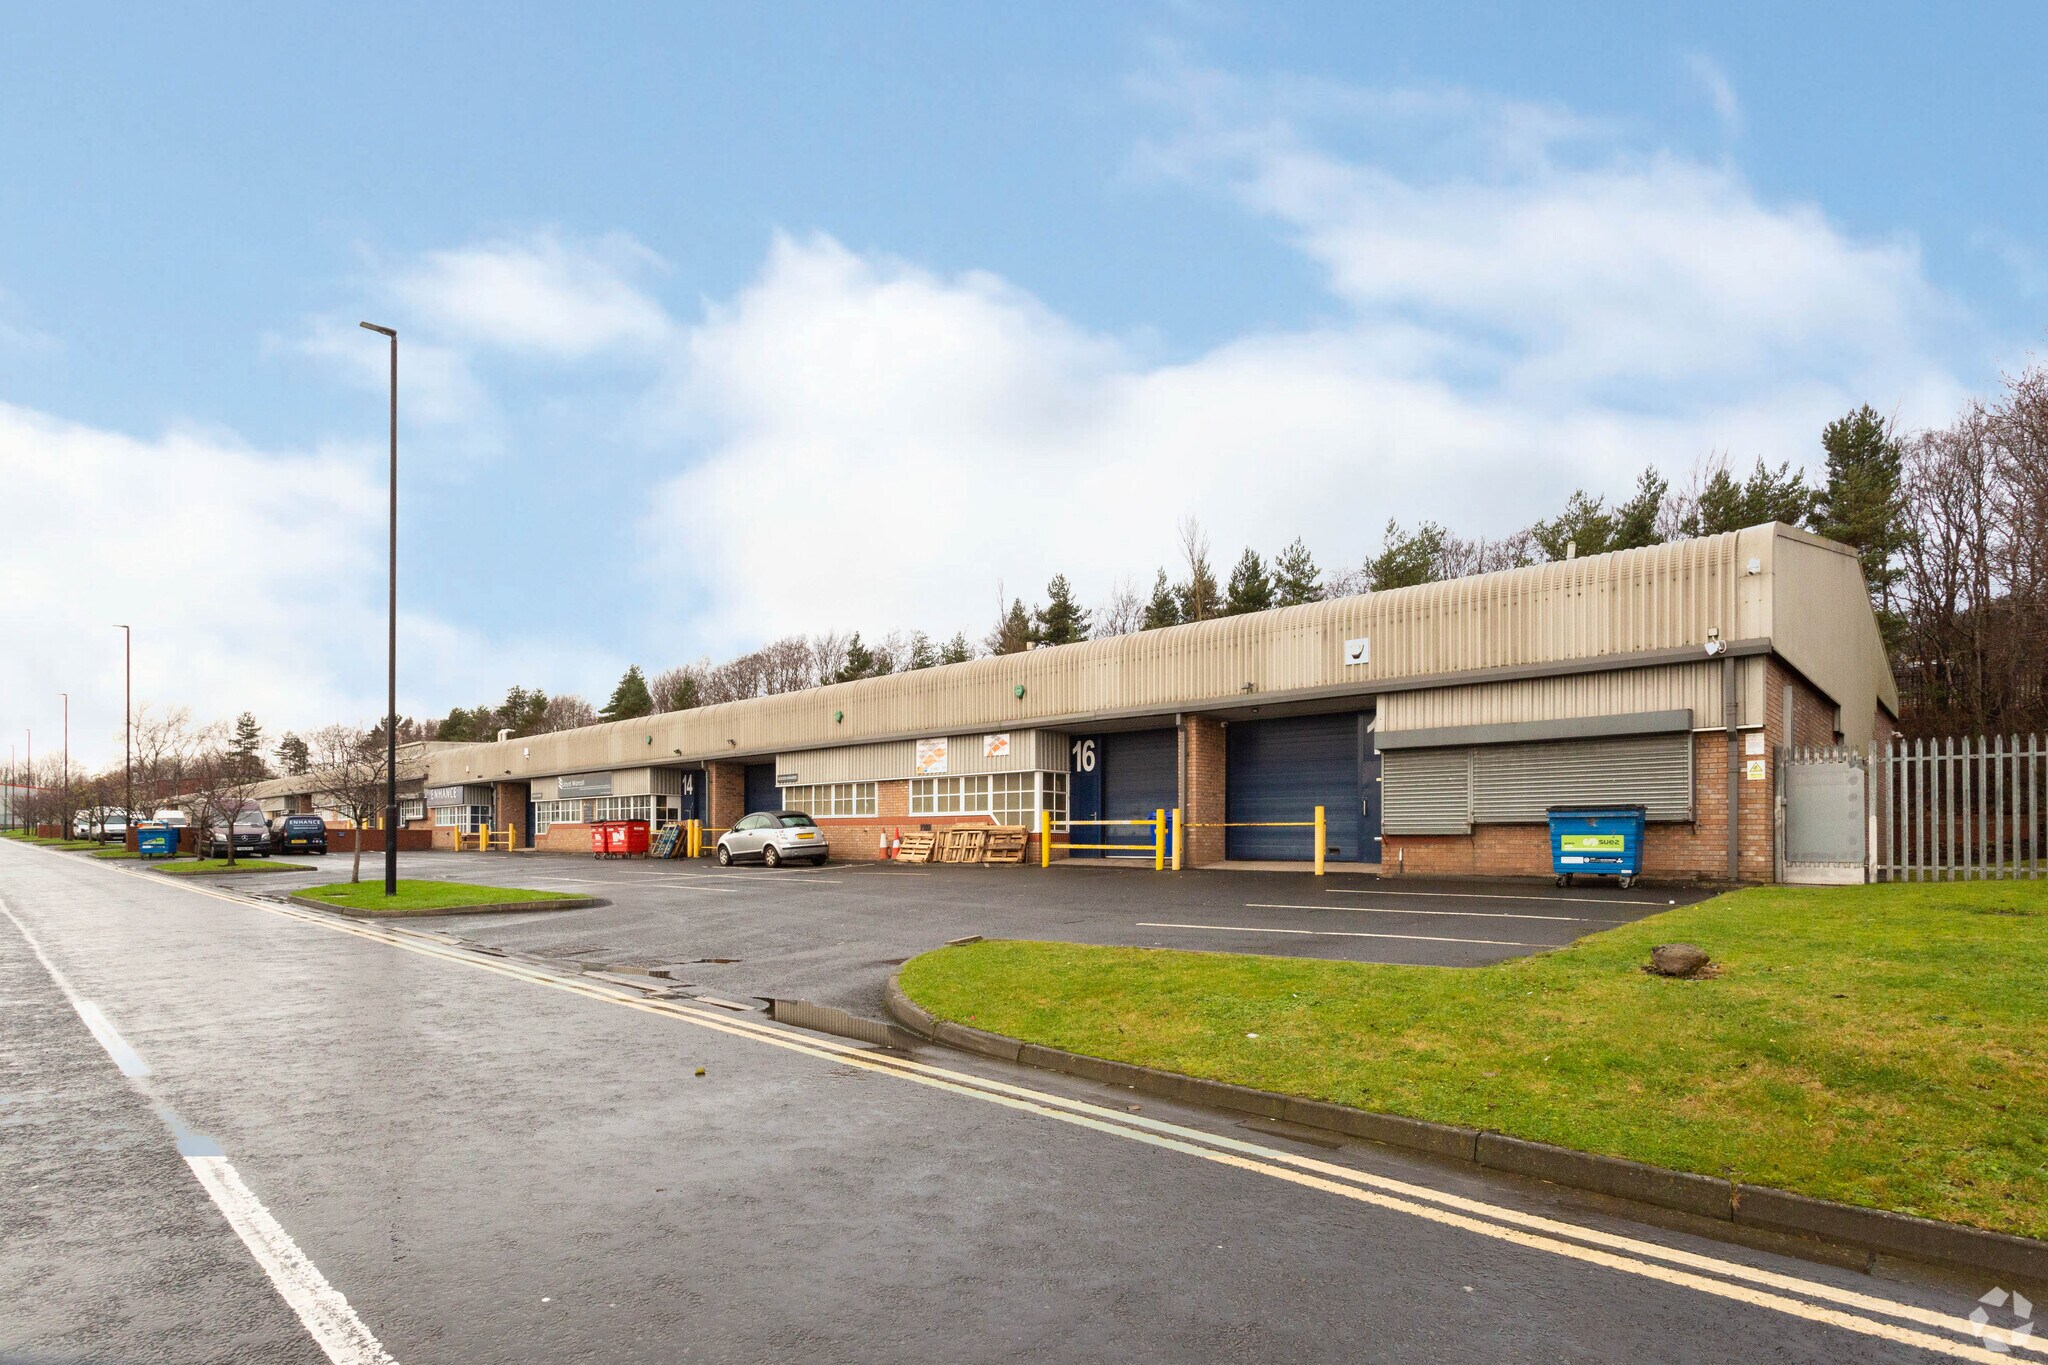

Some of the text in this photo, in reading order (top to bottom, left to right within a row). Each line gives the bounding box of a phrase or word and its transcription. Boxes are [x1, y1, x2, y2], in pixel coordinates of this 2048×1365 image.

[1072, 739, 1096, 772] 16
[430, 786, 457, 800] ENHANCE
[682, 774, 694, 795] 14
